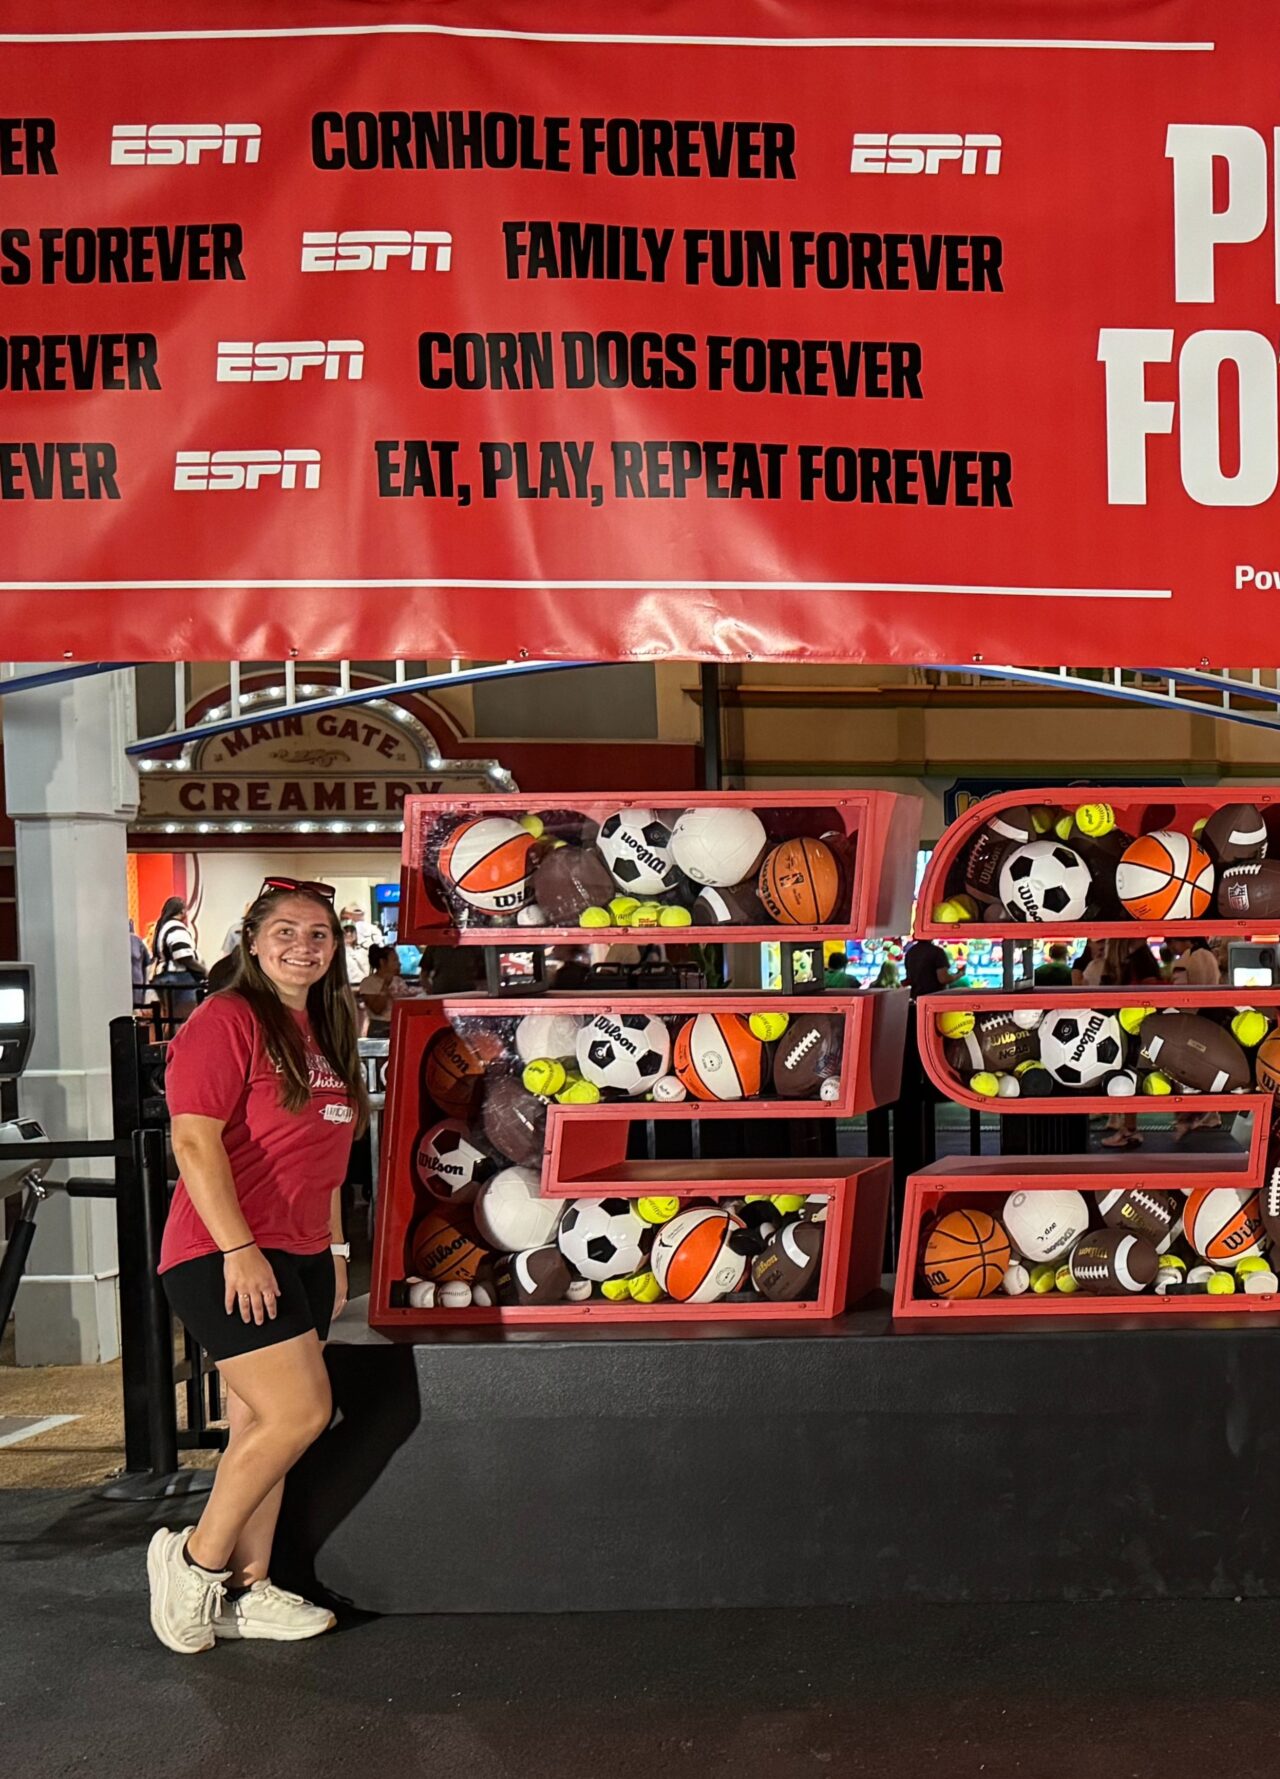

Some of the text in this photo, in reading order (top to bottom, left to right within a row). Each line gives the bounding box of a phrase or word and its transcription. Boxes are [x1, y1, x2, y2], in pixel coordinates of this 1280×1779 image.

[0, 117, 59, 176] ER
[110, 123, 262, 165] ESPN
[311, 110, 797, 180] CORNHOLE FOREVER
[850, 133, 1002, 175] ESPN
[39, 223, 246, 285] FOREVER
[300, 230, 453, 273] ESPN
[502, 221, 1004, 293] FAMILY FUN FOREVER
[216, 339, 364, 382] ESPN
[418, 330, 923, 399] CORN DOGS FOREVER
[0, 442, 121, 500] EVER
[173, 449, 321, 491] ESPN
[374, 440, 1013, 508] EAT, PLAY, REPEAT FOREVER
[221, 713, 401, 760] MAIN GATE
[620, 830, 667, 875] Wilson
[593, 1015, 638, 1056] Wilson
[989, 1029, 1030, 1046] Wilson
[1070, 1016, 1104, 1062] Wilson
[418, 1151, 465, 1177] Wilson
